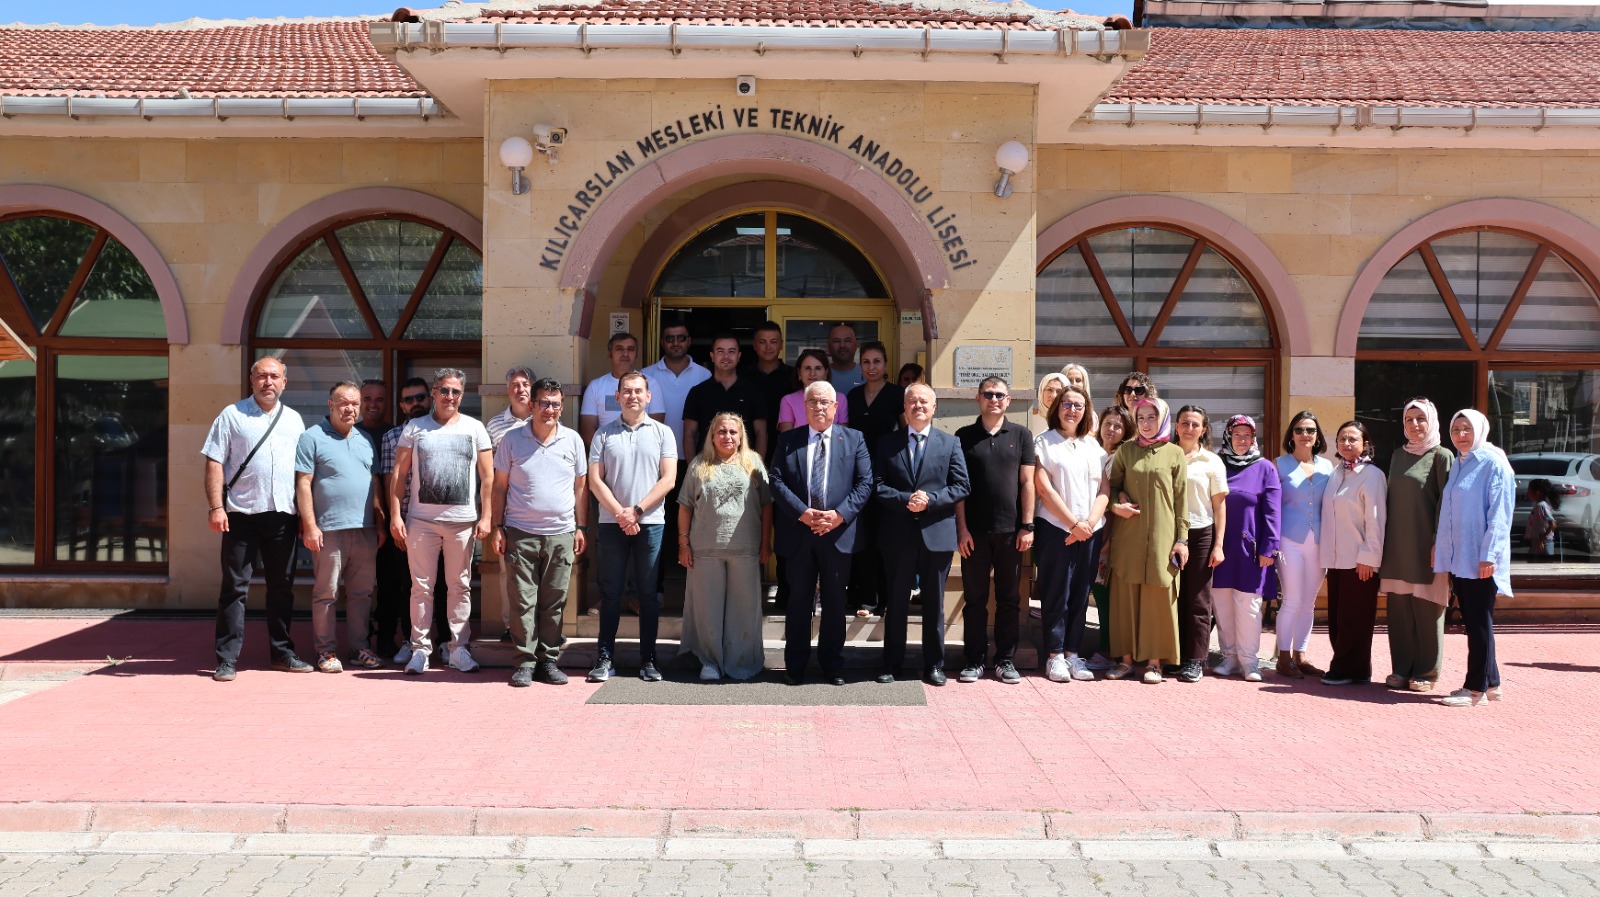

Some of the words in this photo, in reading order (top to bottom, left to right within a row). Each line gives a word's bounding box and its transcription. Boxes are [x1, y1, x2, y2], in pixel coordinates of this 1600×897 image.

[539, 149, 636, 272] KILIÇARSLAN
[636, 104, 725, 159] MESLEKİ
[732, 107, 759, 128] VE
[769, 108, 845, 145] TEKNİK
[847, 134, 934, 204] ANADOLU
[926, 205, 978, 271] LİSESİ
